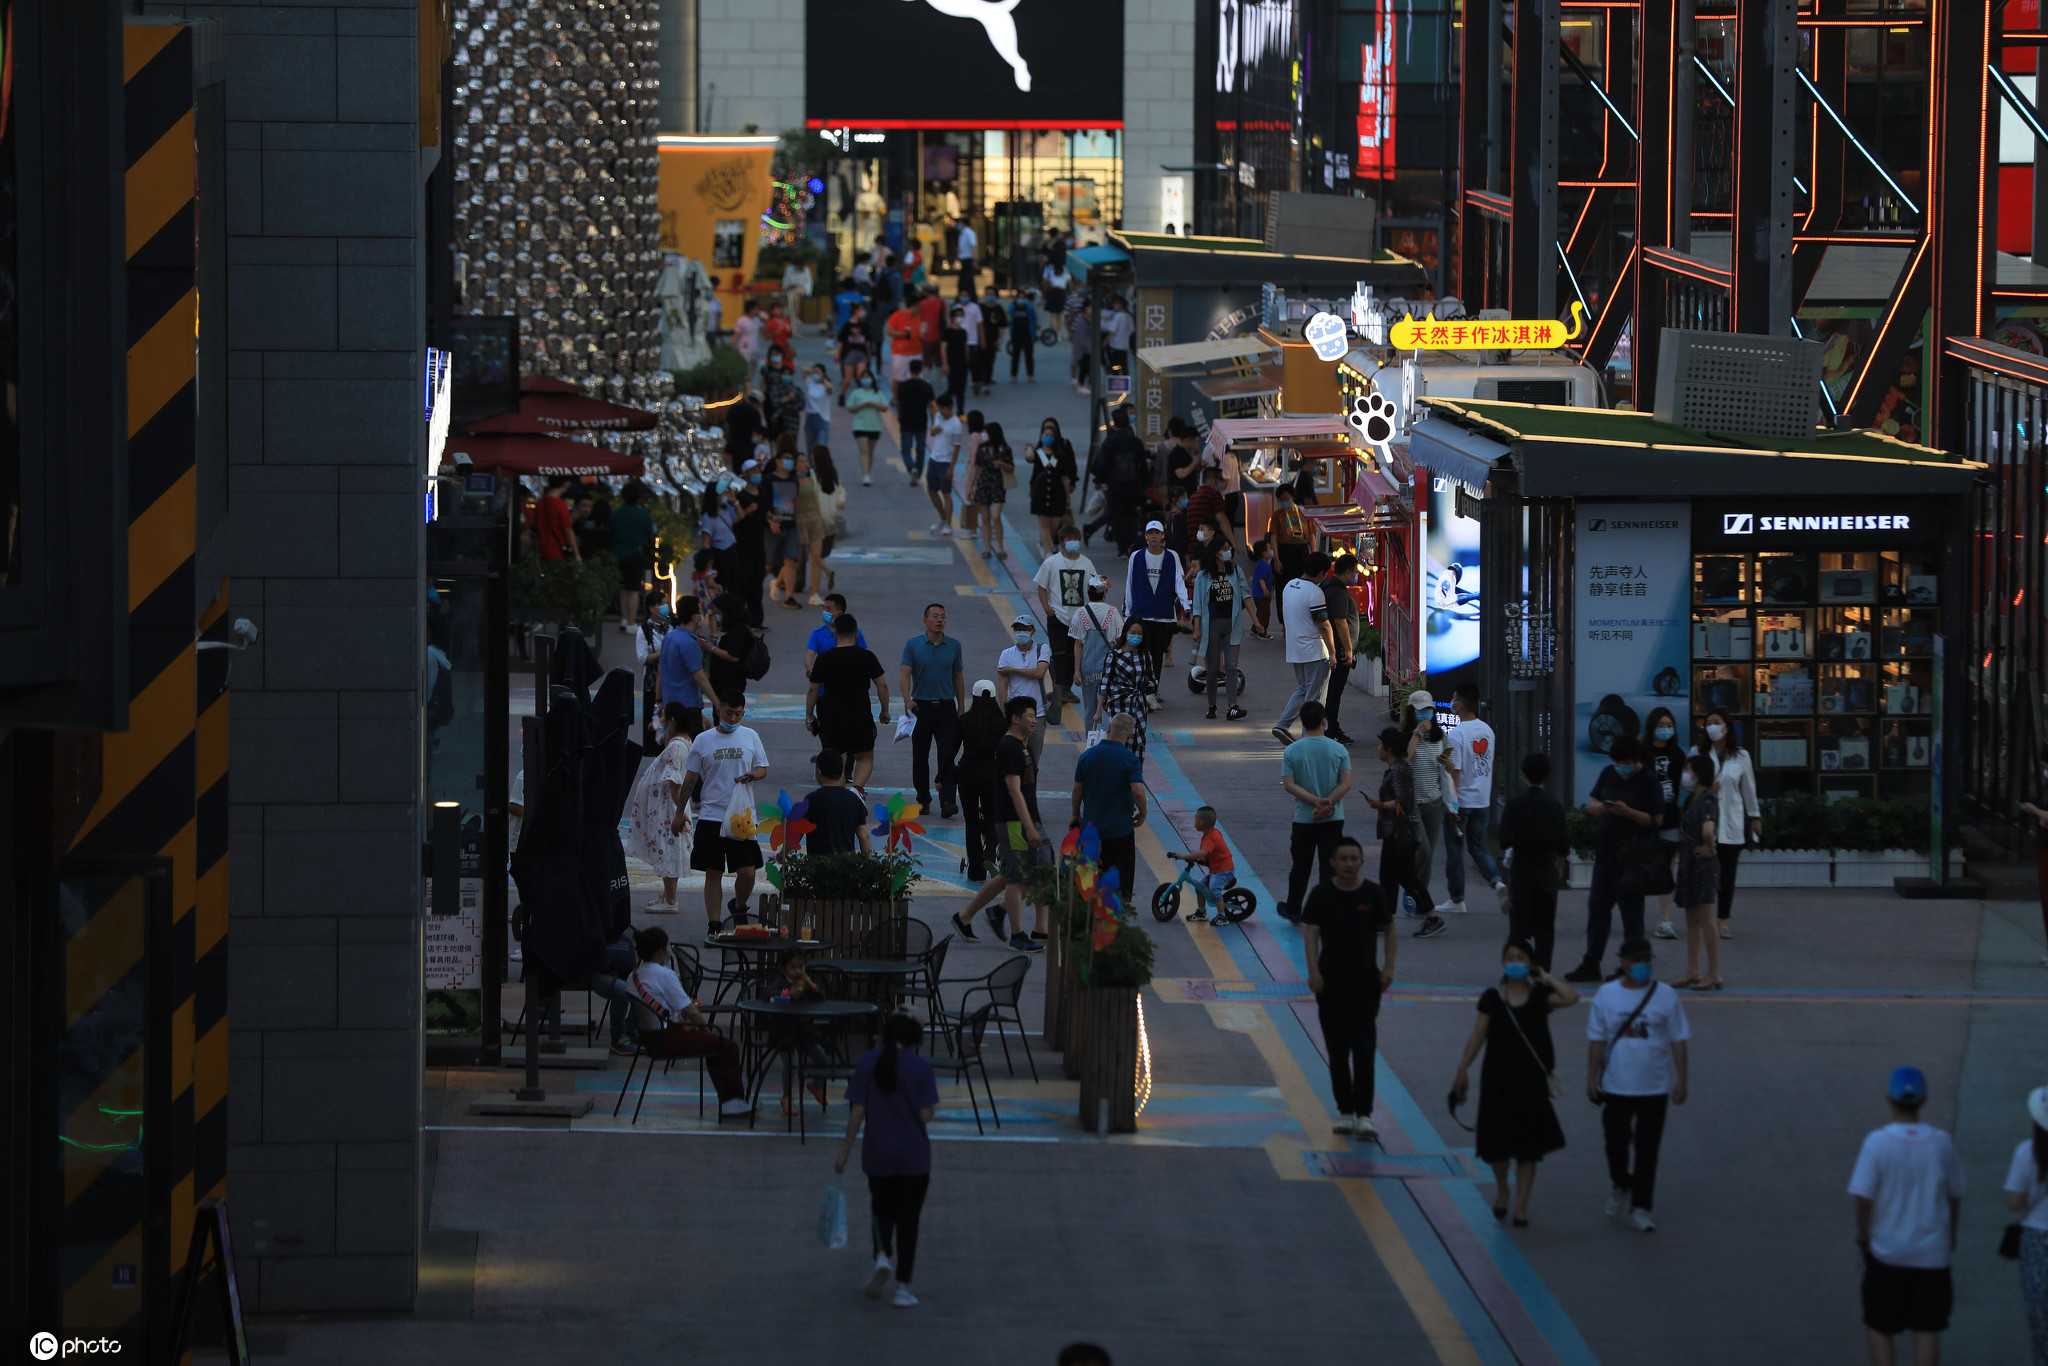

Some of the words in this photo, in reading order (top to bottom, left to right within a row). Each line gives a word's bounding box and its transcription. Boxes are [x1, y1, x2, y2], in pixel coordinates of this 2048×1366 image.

[1410, 326, 1552, 345] 天然手作冰淇淋
[581, 417, 629, 428] COFFEE
[538, 466, 572, 476] COSTA
[572, 466, 611, 476] COFFEE
[1610, 520, 1679, 529] SENNHEISER
[1759, 515, 1910, 531] SENNHEISER
[1589, 565, 1648, 580] 先声夺人
[1589, 582, 1648, 597] 静享佳音
[1589, 619, 1639, 627] MOMENTUM
[1589, 630, 1634, 641] 听见不同
